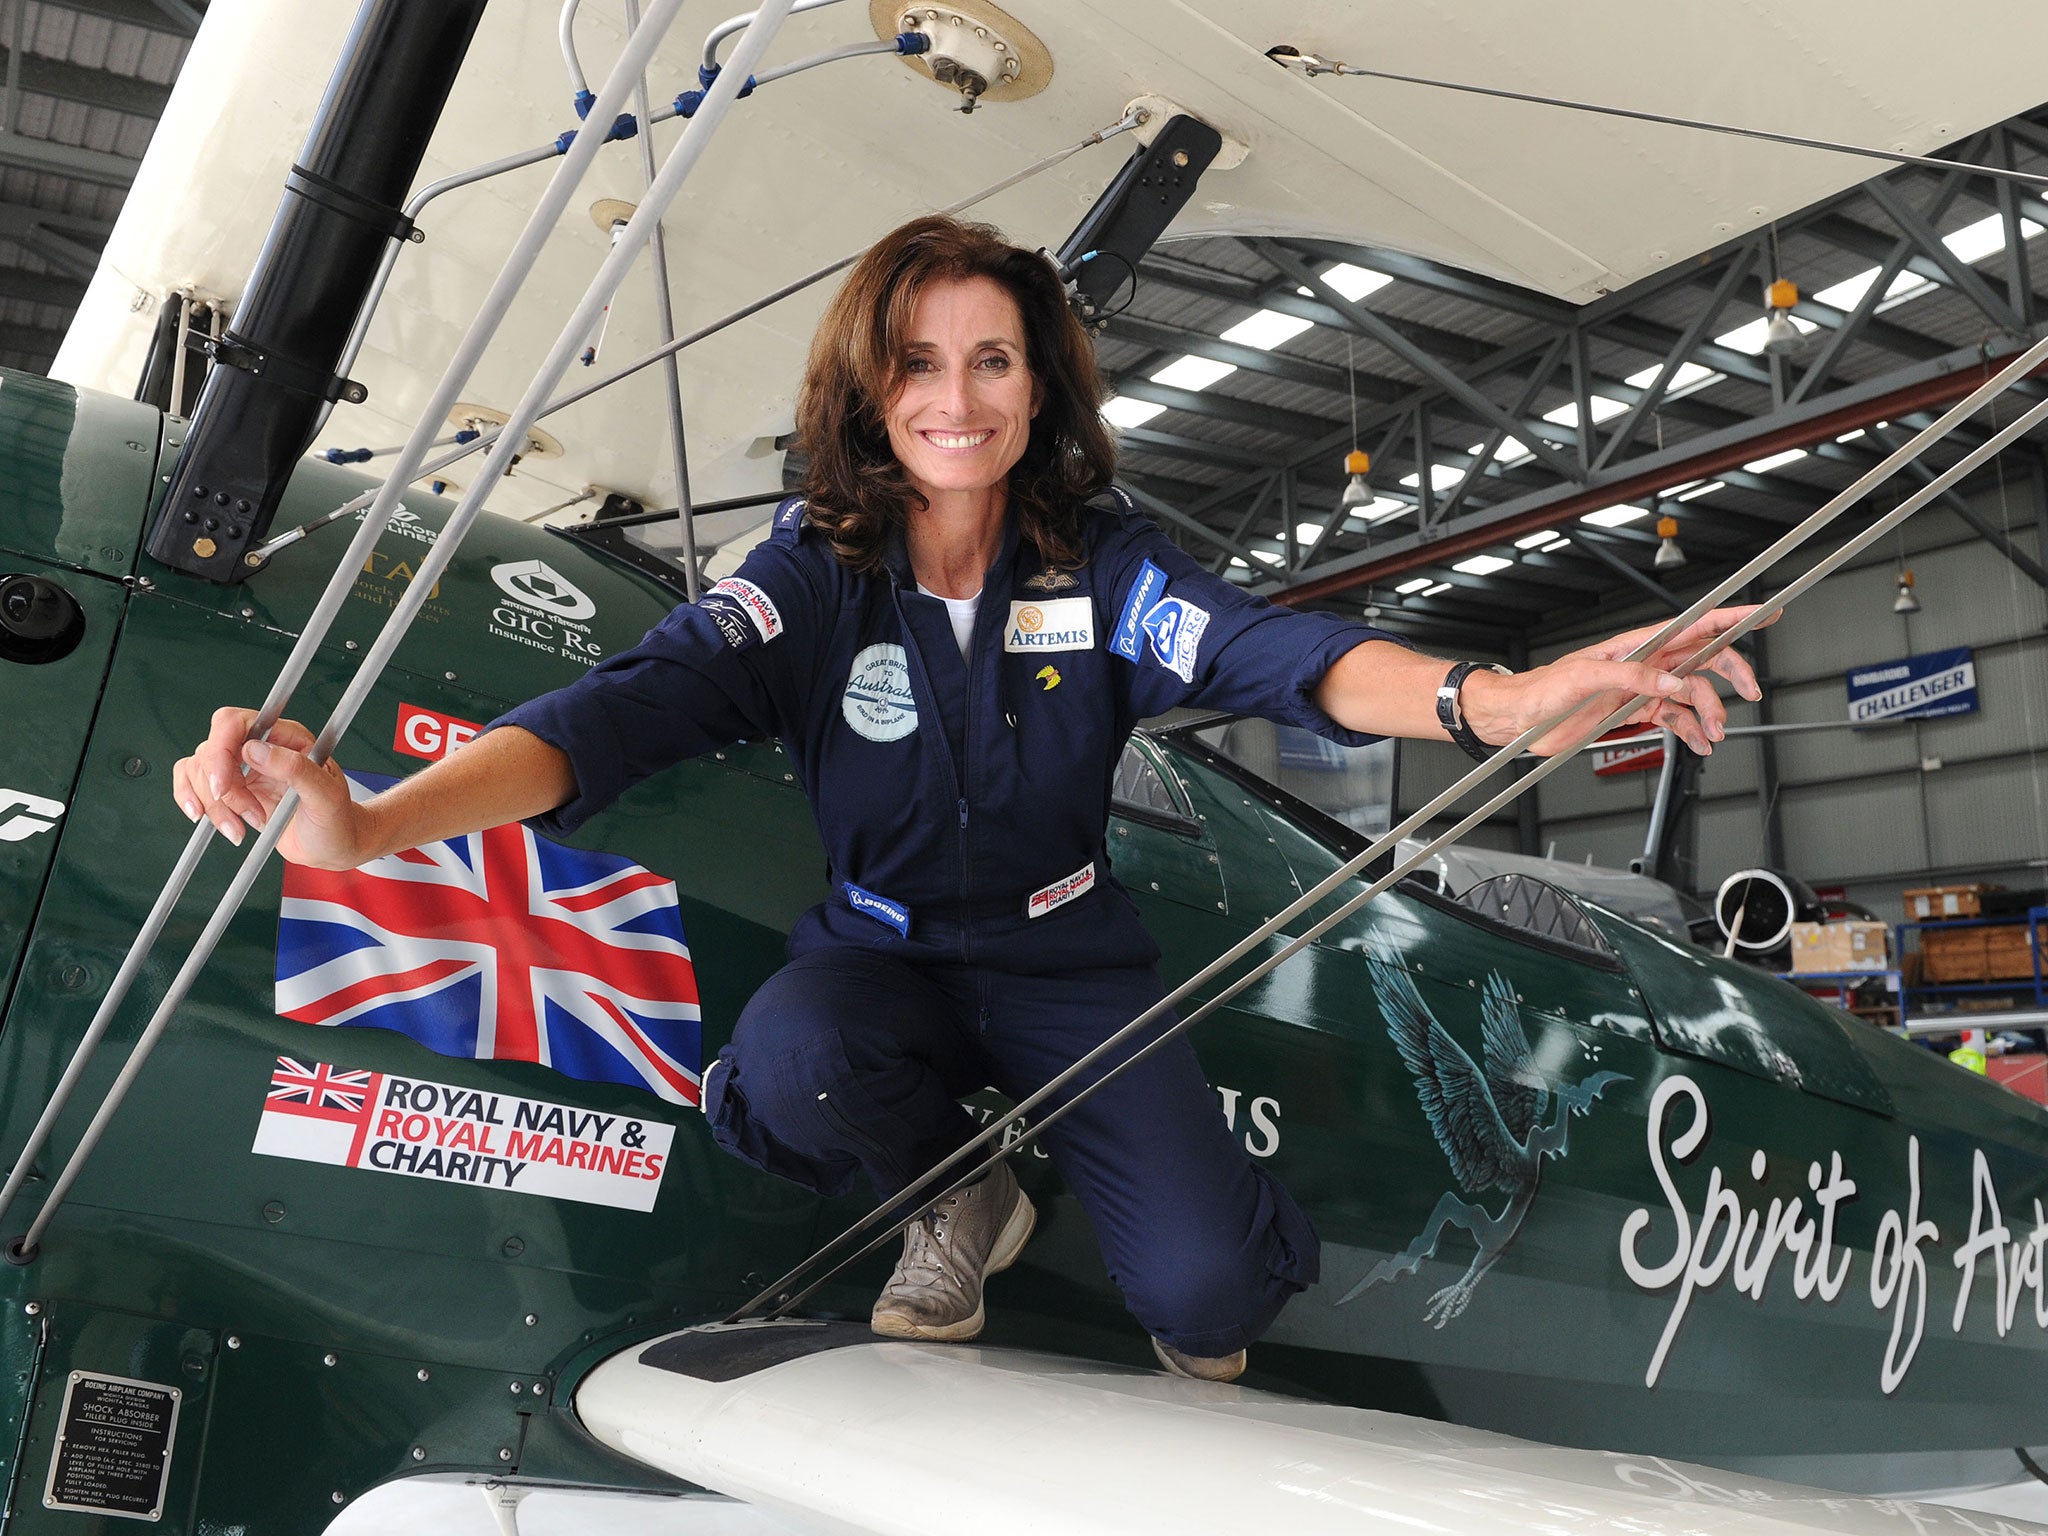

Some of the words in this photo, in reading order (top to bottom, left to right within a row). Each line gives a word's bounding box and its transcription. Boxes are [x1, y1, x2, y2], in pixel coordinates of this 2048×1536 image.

[727, 582, 751, 599] ROYAL
[750, 596, 776, 635] MARINES
[732, 580, 755, 597] ROYAL
[754, 594, 775, 616] NAVY
[1127, 569, 1154, 635] BOEING
[488, 623, 555, 654] Insurance
[492, 607, 554, 640] GIC
[562, 629, 602, 656] Re
[1009, 628, 1088, 646] ARTEMIS
[865, 659, 888, 672] GREAT
[847, 674, 912, 700] Austral
[1856, 670, 1966, 720] CHALLENGER
[880, 712, 907, 726] BIPLANE
[1049, 881, 1069, 895] ROYAL
[1069, 871, 1085, 886] NAVY
[1049, 887, 1069, 901] ROYAL
[1069, 871, 1094, 891] MARINES
[864, 898, 906, 922] BOEING
[1049, 890, 1076, 907] CHARITY
[384, 1078, 504, 1125] ROYAL
[515, 1101, 617, 1142] NAVY
[620, 1121, 647, 1149] &
[376, 1109, 497, 1155] ROYAL
[505, 1130, 664, 1181] MARINES
[368, 1140, 527, 1188] CHARITY
[1619, 1074, 1857, 1388] Spirit
[1870, 1134, 1939, 1394] of
[85, 1381, 107, 1390] BOEING
[108, 1385, 136, 1396] AIRPLANE
[137, 1390, 165, 1400] COMPANY
[83, 1403, 114, 1414] SHOCK
[118, 1409, 160, 1422] ABSORBER
[126, 1401, 150, 1409] KANSAS
[85, 1412, 107, 1421] FILLER
[110, 1416, 128, 1425] PLUG
[130, 1419, 154, 1429] INSIDE
[91, 1427, 143, 1442] INSTRUCTIONS
[108, 1437, 138, 1448] SERVICING
[68, 1467, 96, 1475] AIRPLANE
[107, 1471, 124, 1479] THREE
[65, 1487, 90, 1495] TIGHTEN
[123, 1495, 148, 1504] SECURELY
